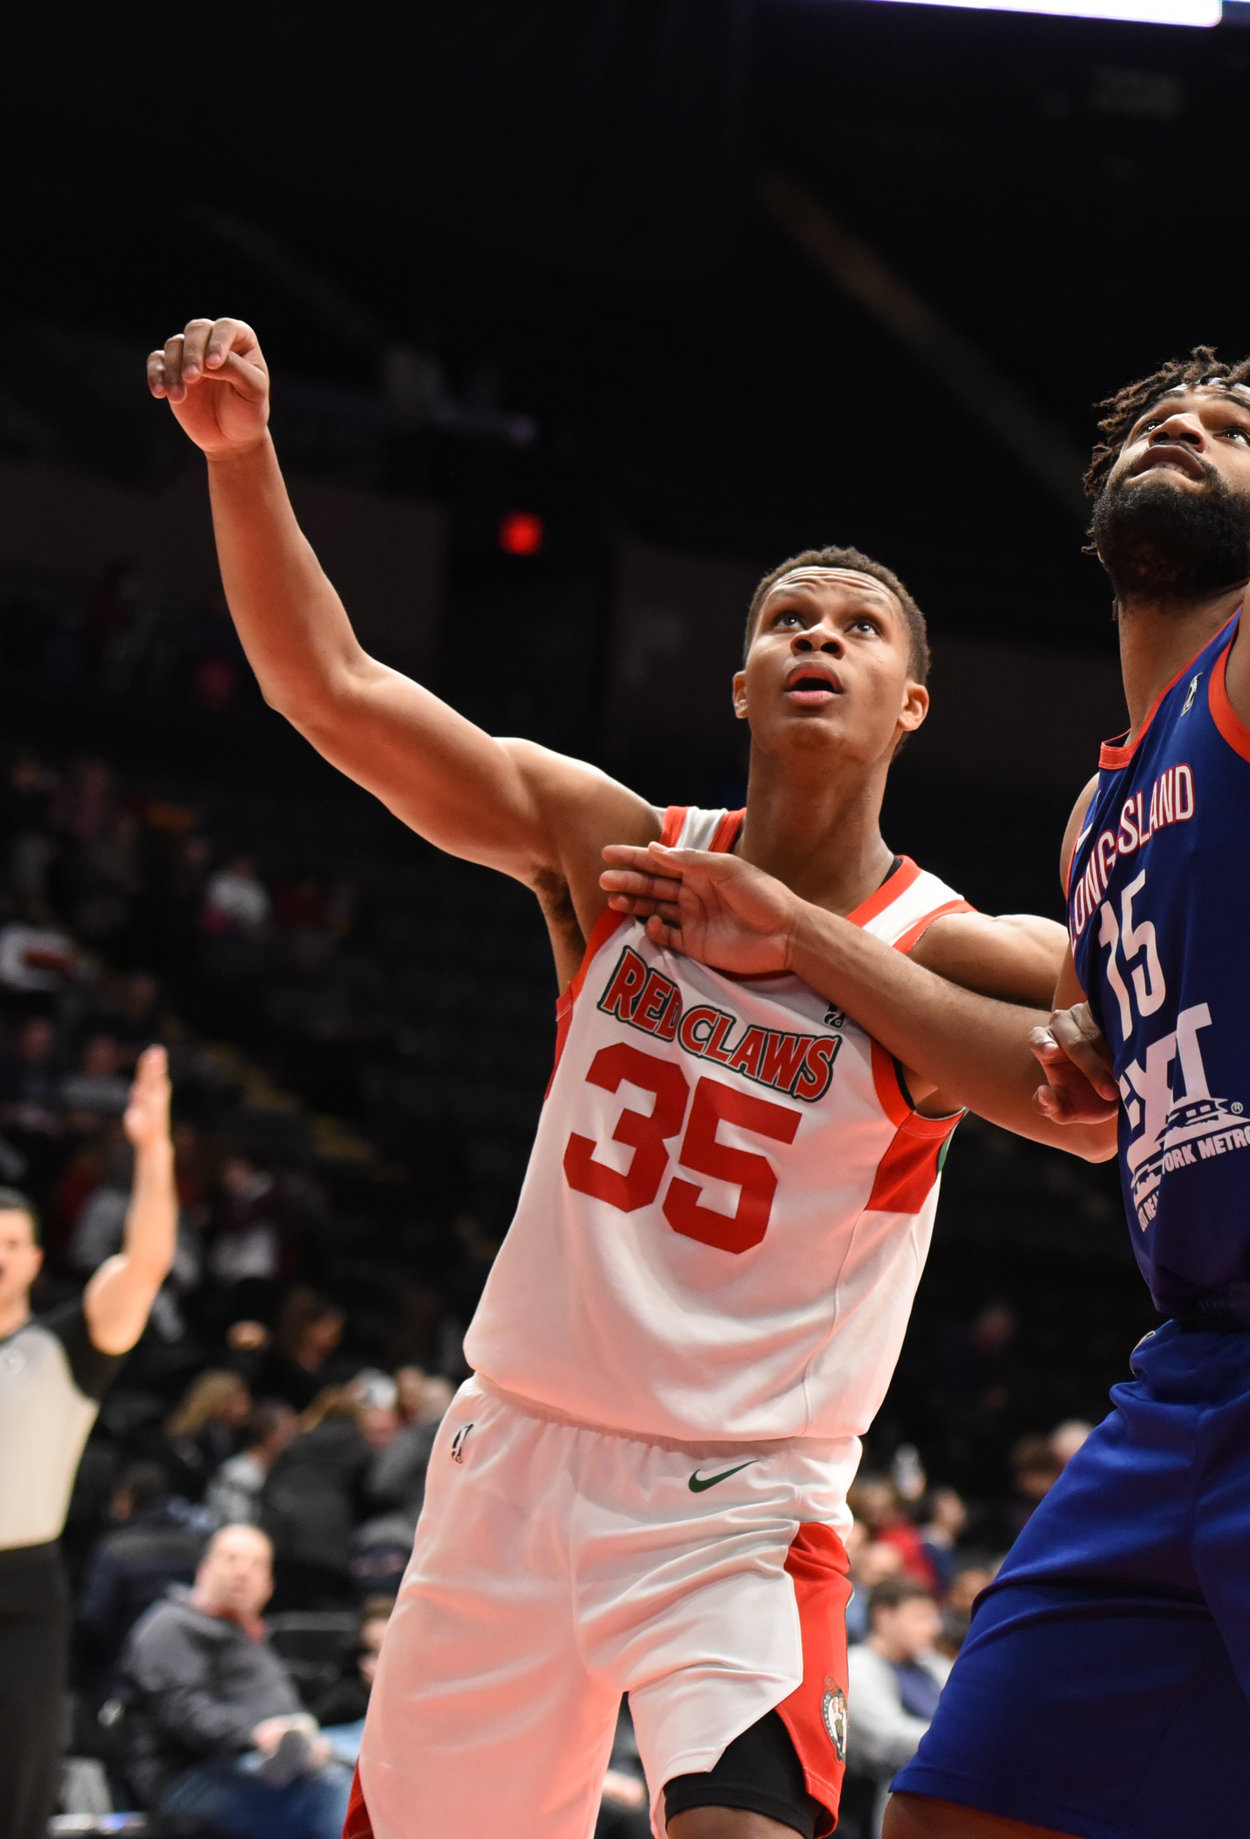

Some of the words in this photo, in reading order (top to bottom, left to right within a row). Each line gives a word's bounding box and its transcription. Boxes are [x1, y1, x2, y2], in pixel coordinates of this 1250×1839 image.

[1118, 763, 1196, 855] SLAND
[563, 1042, 803, 1255] 35
[1162, 1143, 1197, 1175] ORK
